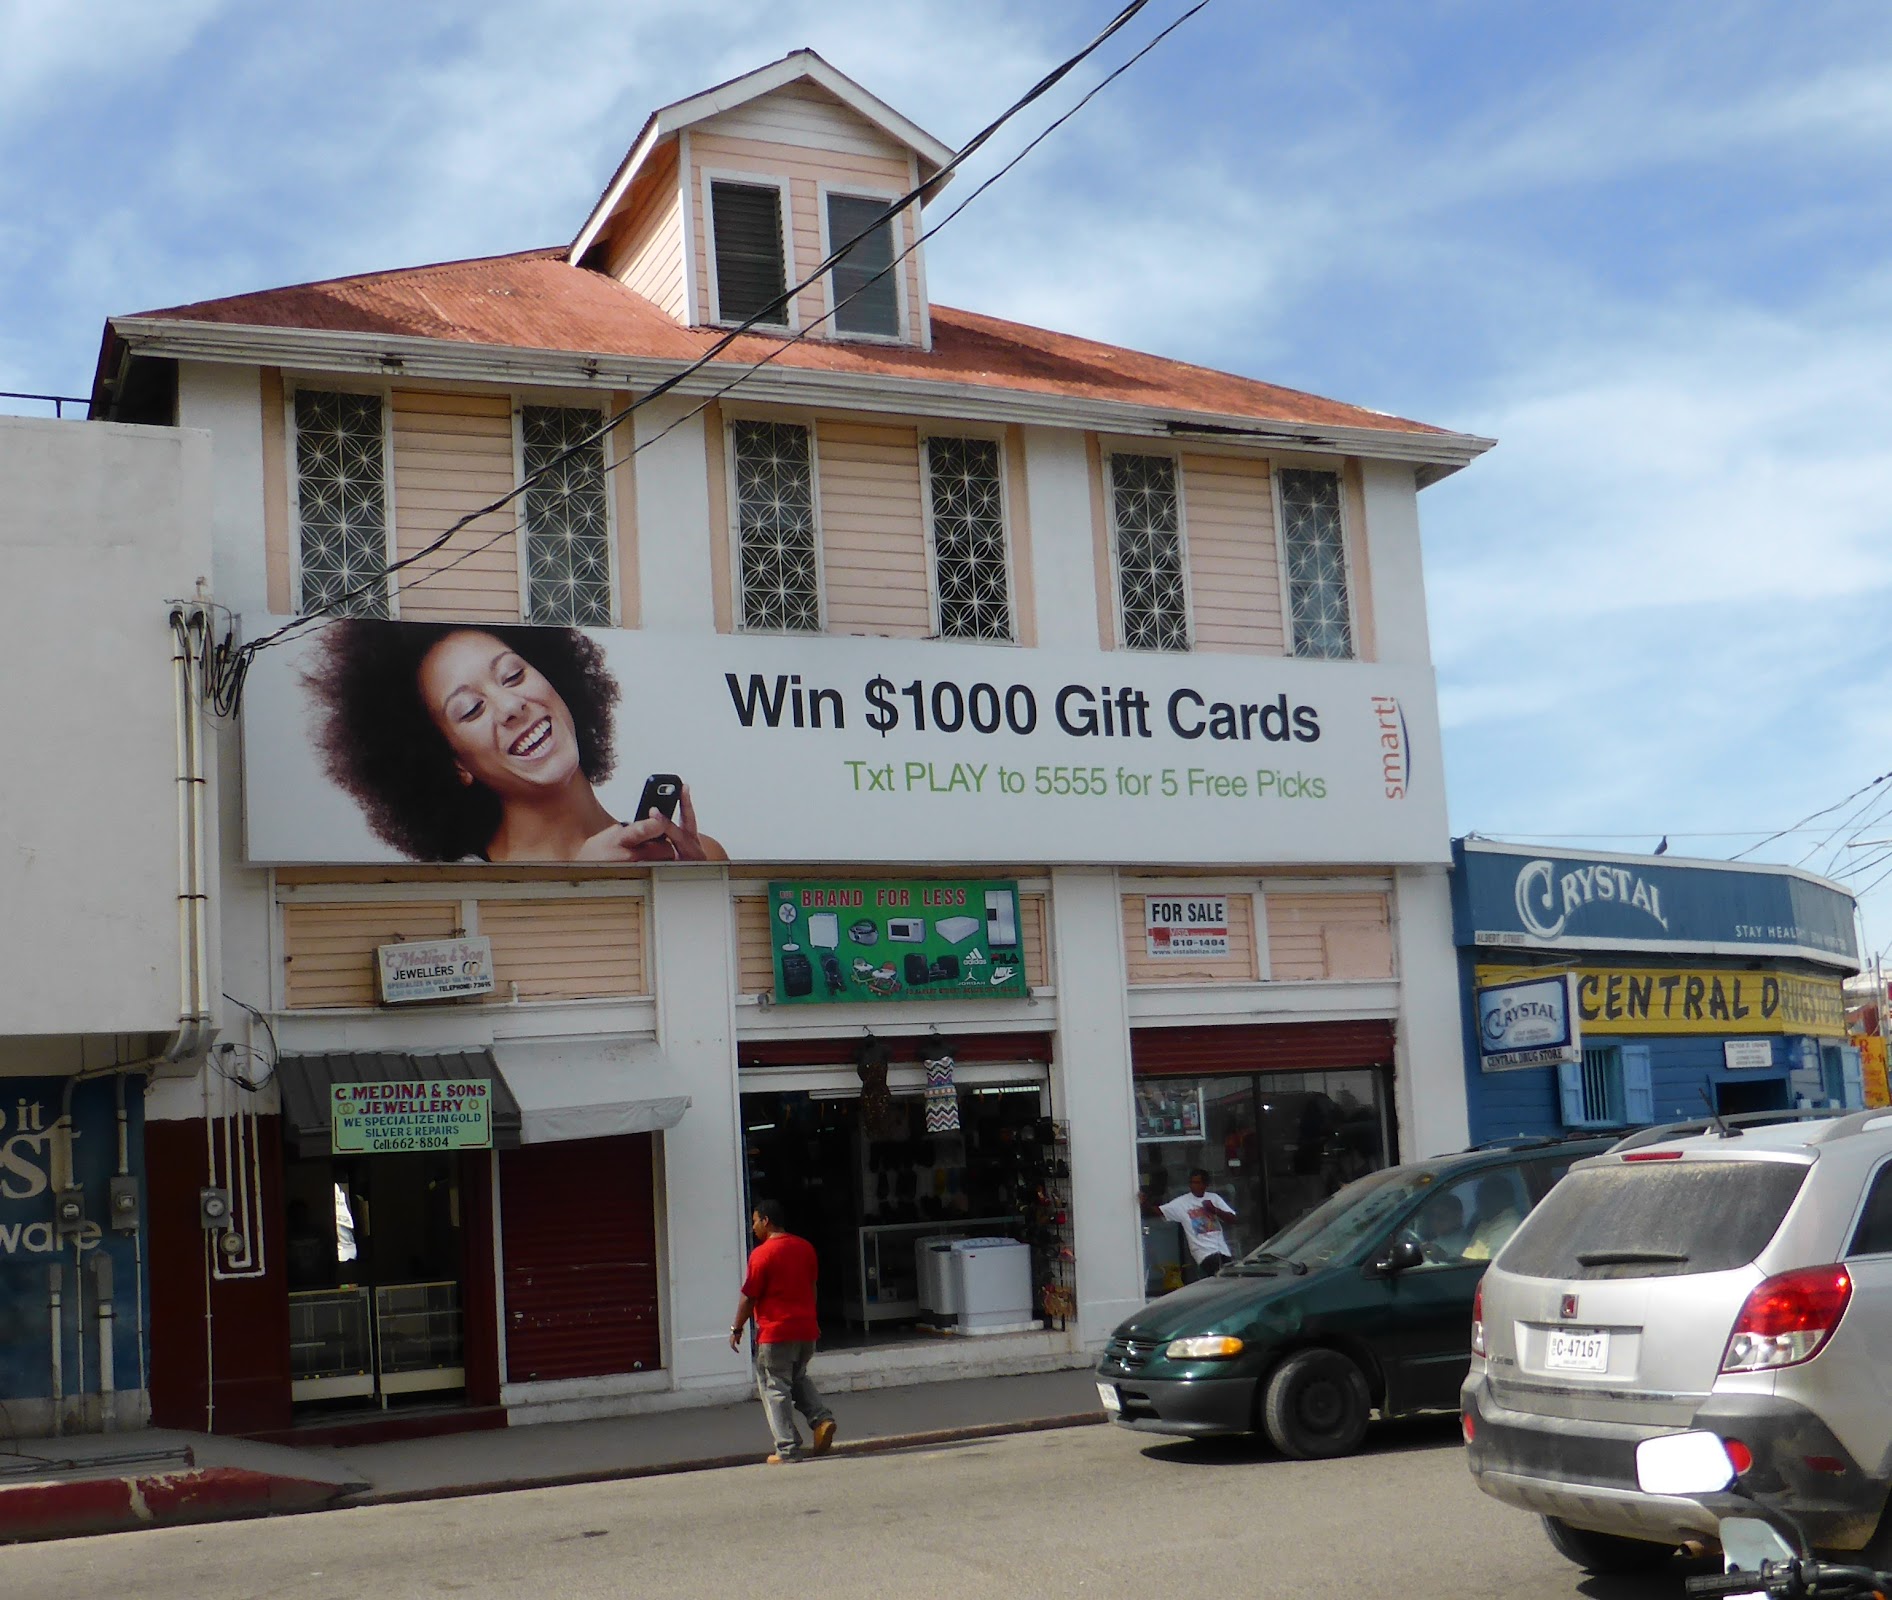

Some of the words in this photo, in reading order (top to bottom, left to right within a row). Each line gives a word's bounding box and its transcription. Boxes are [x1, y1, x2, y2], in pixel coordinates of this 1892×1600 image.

[724, 672, 845, 729] Win
[865, 674, 1037, 738] $1000
[1055, 684, 1152, 738] Gift
[1167, 688, 1321, 743] Cards
[1371, 696, 1404, 800] smart!
[844, 761, 895, 791] Txt
[905, 762, 988, 793] PLAY
[998, 766, 1025, 794] to
[1035, 766, 1107, 796] 5555
[1116, 766, 1152, 796] for
[1161, 768, 1178, 797] 5
[1188, 768, 1248, 798] Free
[1257, 769, 1327, 799] Picks
[802, 888, 864, 907] BRAND
[876, 888, 910, 907] FOR
[923, 887, 966, 907] LESS
[1515, 860, 1669, 938] CRYSTAL
[1152, 902, 1182, 922] FOR
[1187, 902, 1223, 922] SALE
[1476, 933, 1500, 943] ALBERT
[1735, 925, 1762, 938] STAY
[990, 953, 1019, 964] FILA
[393, 965, 454, 980] JEWELLERS
[1577, 974, 1749, 1021] CENTRAL
[1484, 1002, 1557, 1039] CRYSTAL
[1540, 1048, 1563, 1062] STORE
[431, 1083, 442, 1099] &
[446, 1084, 486, 1098] SONS
[359, 1100, 464, 1115] JEWELLERY
[344, 1117, 362, 1127] WE
[365, 1114, 434, 1127] SPECIALIZE
[365, 1127, 403, 1138] SILVER
[415, 1125, 459, 1136] REPAIRS
[1557, 1338, 1602, 1359] C-47167
